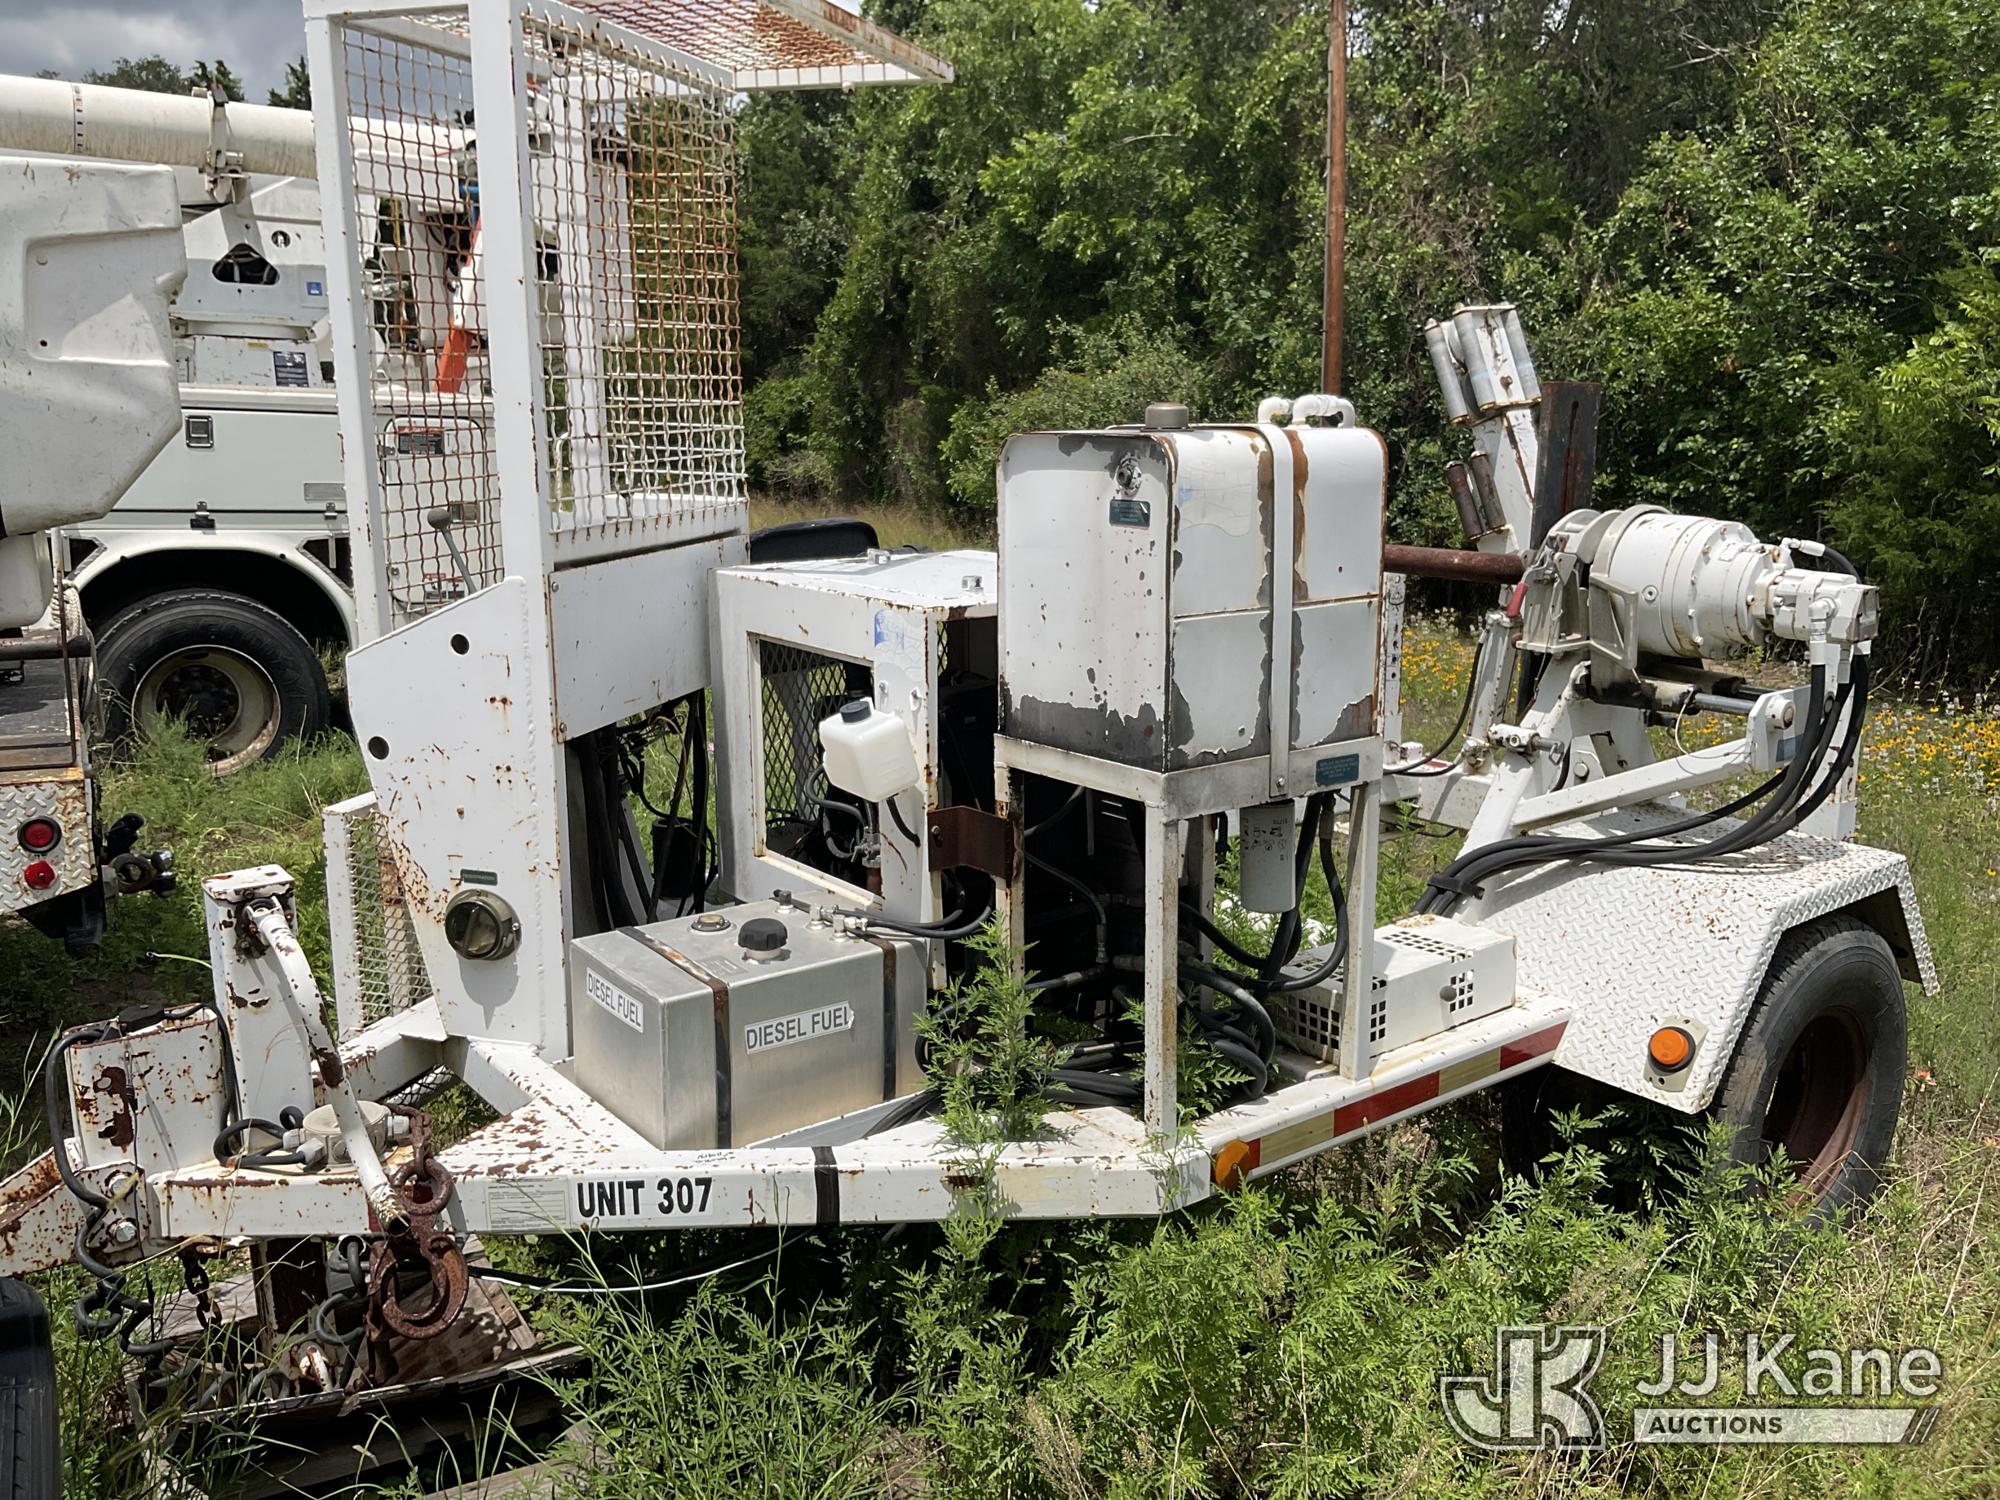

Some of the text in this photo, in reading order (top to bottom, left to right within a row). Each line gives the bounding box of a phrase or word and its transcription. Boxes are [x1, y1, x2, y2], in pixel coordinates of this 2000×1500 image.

[587, 973, 642, 1028] DIESEL FUEL
[746, 1006, 850, 1050] DIESEL FUEL
[576, 1179, 646, 1218] UNIT
[656, 1176, 713, 1215] 307
